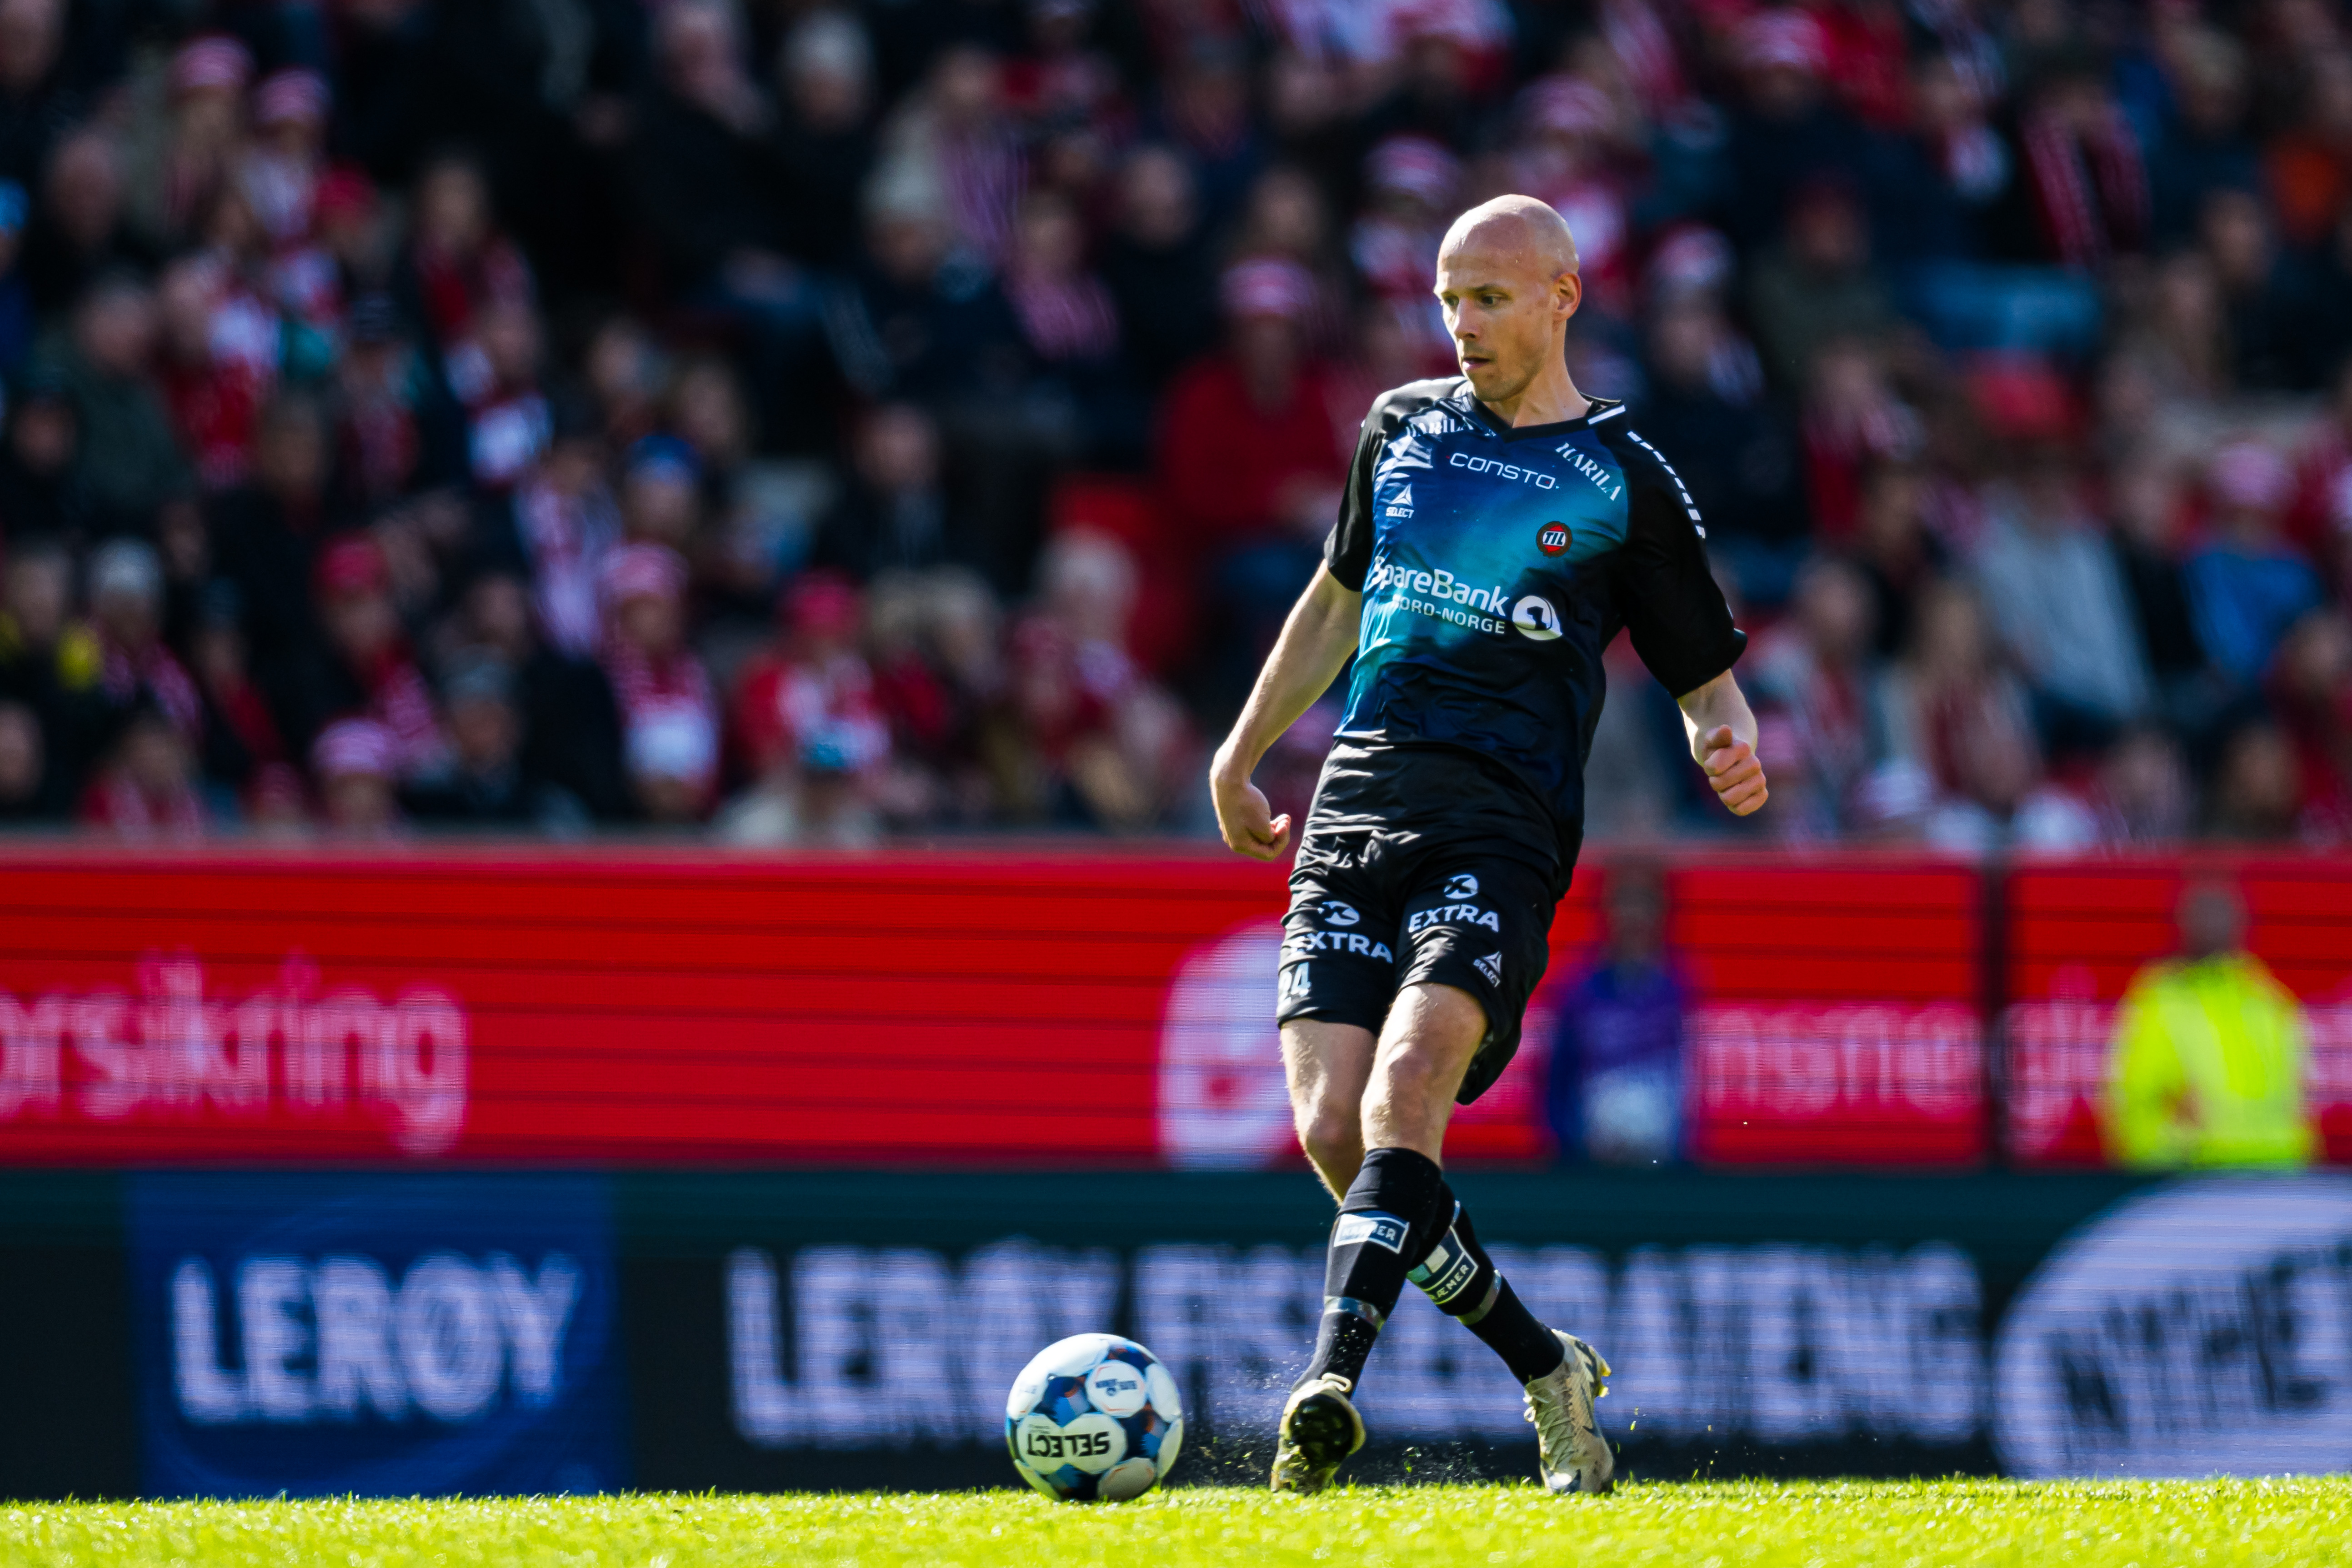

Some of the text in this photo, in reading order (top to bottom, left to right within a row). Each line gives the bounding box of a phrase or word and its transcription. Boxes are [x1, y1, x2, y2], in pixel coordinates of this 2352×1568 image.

[1555, 441, 1621, 501] HARILA
[1385, 506, 1415, 519] SELECT
[1544, 532, 1565, 546] TIL
[1408, 904, 1499, 933] EXTRA
[1473, 959, 1500, 987] SELECT
[1027, 1431, 1110, 1458] SELECT
